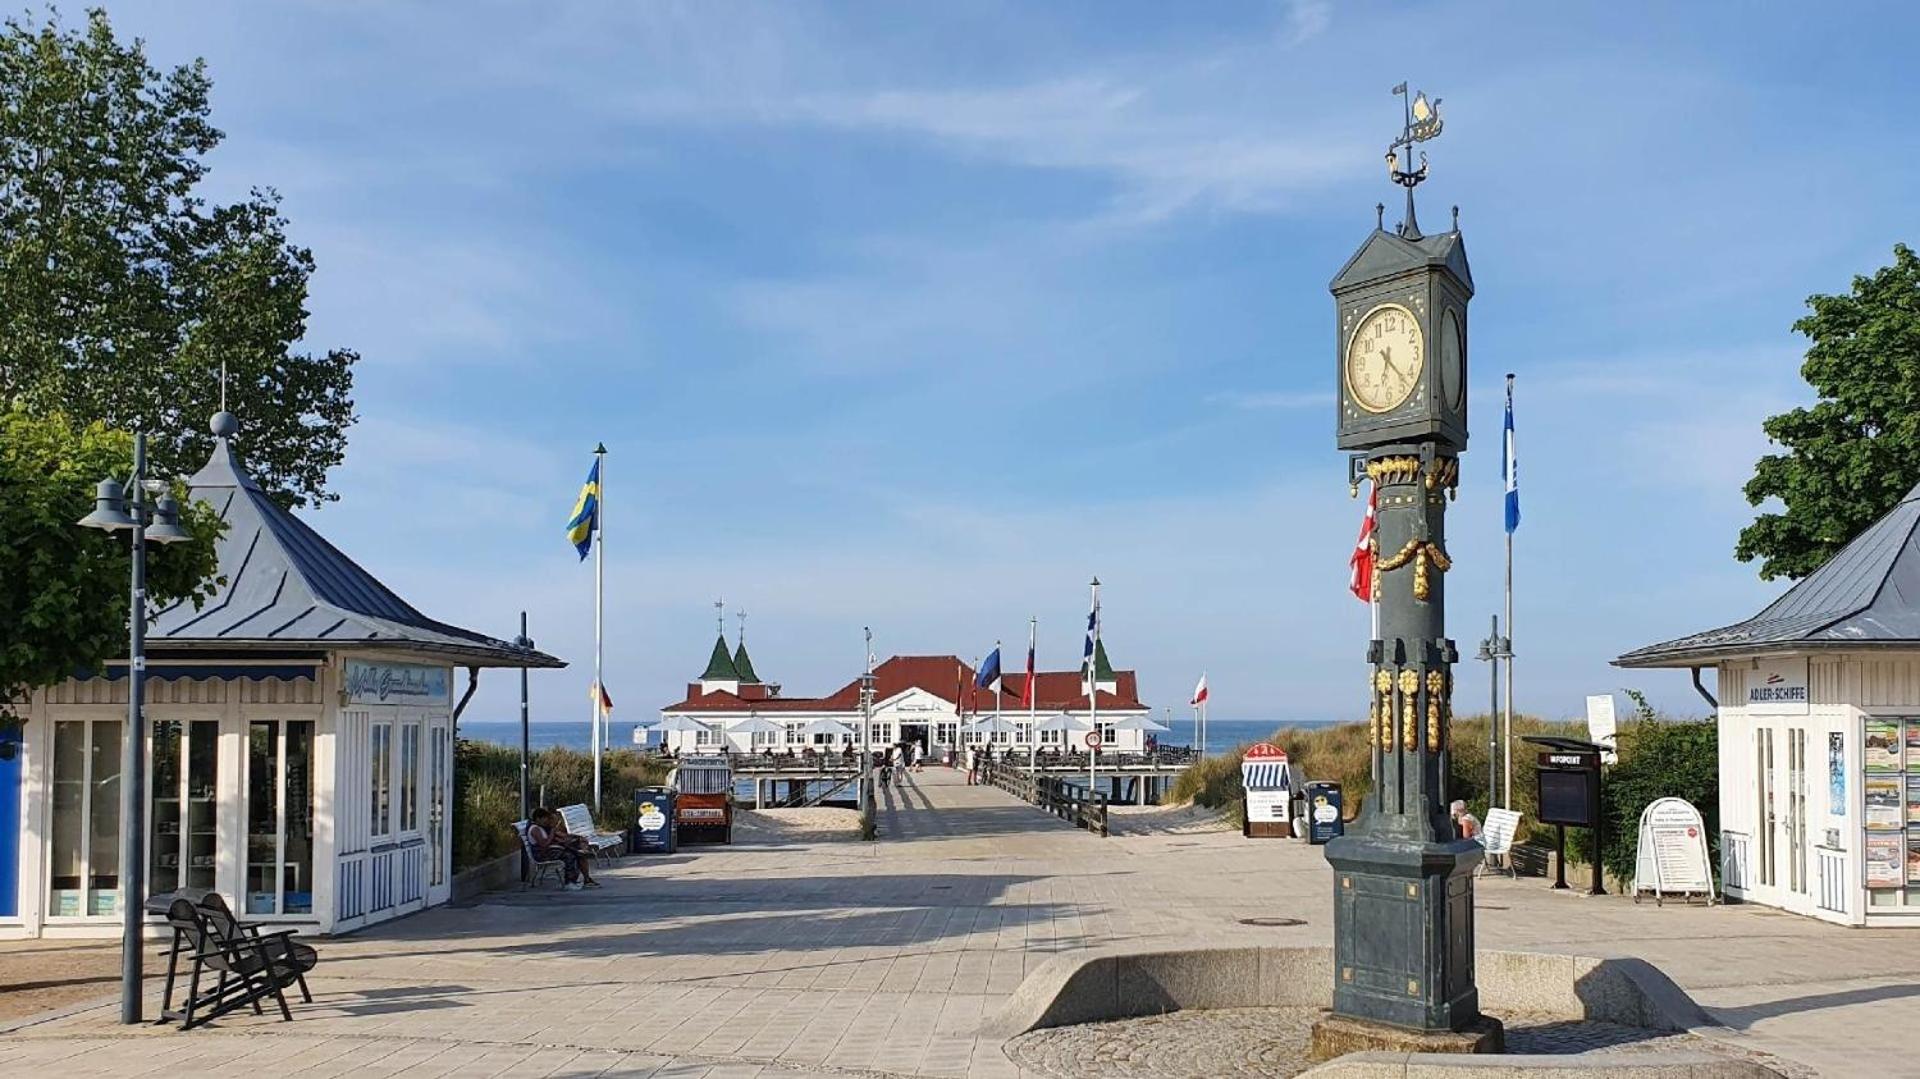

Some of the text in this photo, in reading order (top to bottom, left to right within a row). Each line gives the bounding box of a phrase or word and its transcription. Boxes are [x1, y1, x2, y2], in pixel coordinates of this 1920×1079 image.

[1375, 323, 1382, 338] 11
[1384, 317, 1396, 332] 12
[1401, 319, 1405, 334] 1
[1409, 329, 1416, 344] 2
[1364, 339, 1374, 353] 10
[1414, 346, 1419, 361] 3
[1407, 364, 1414, 379] 4
[1364, 373, 1370, 387] 8
[1374, 384, 1379, 398] 7
[1385, 386, 1392, 400] 6
[1750, 687, 1805, 700] ADLER-SCHIFFE
